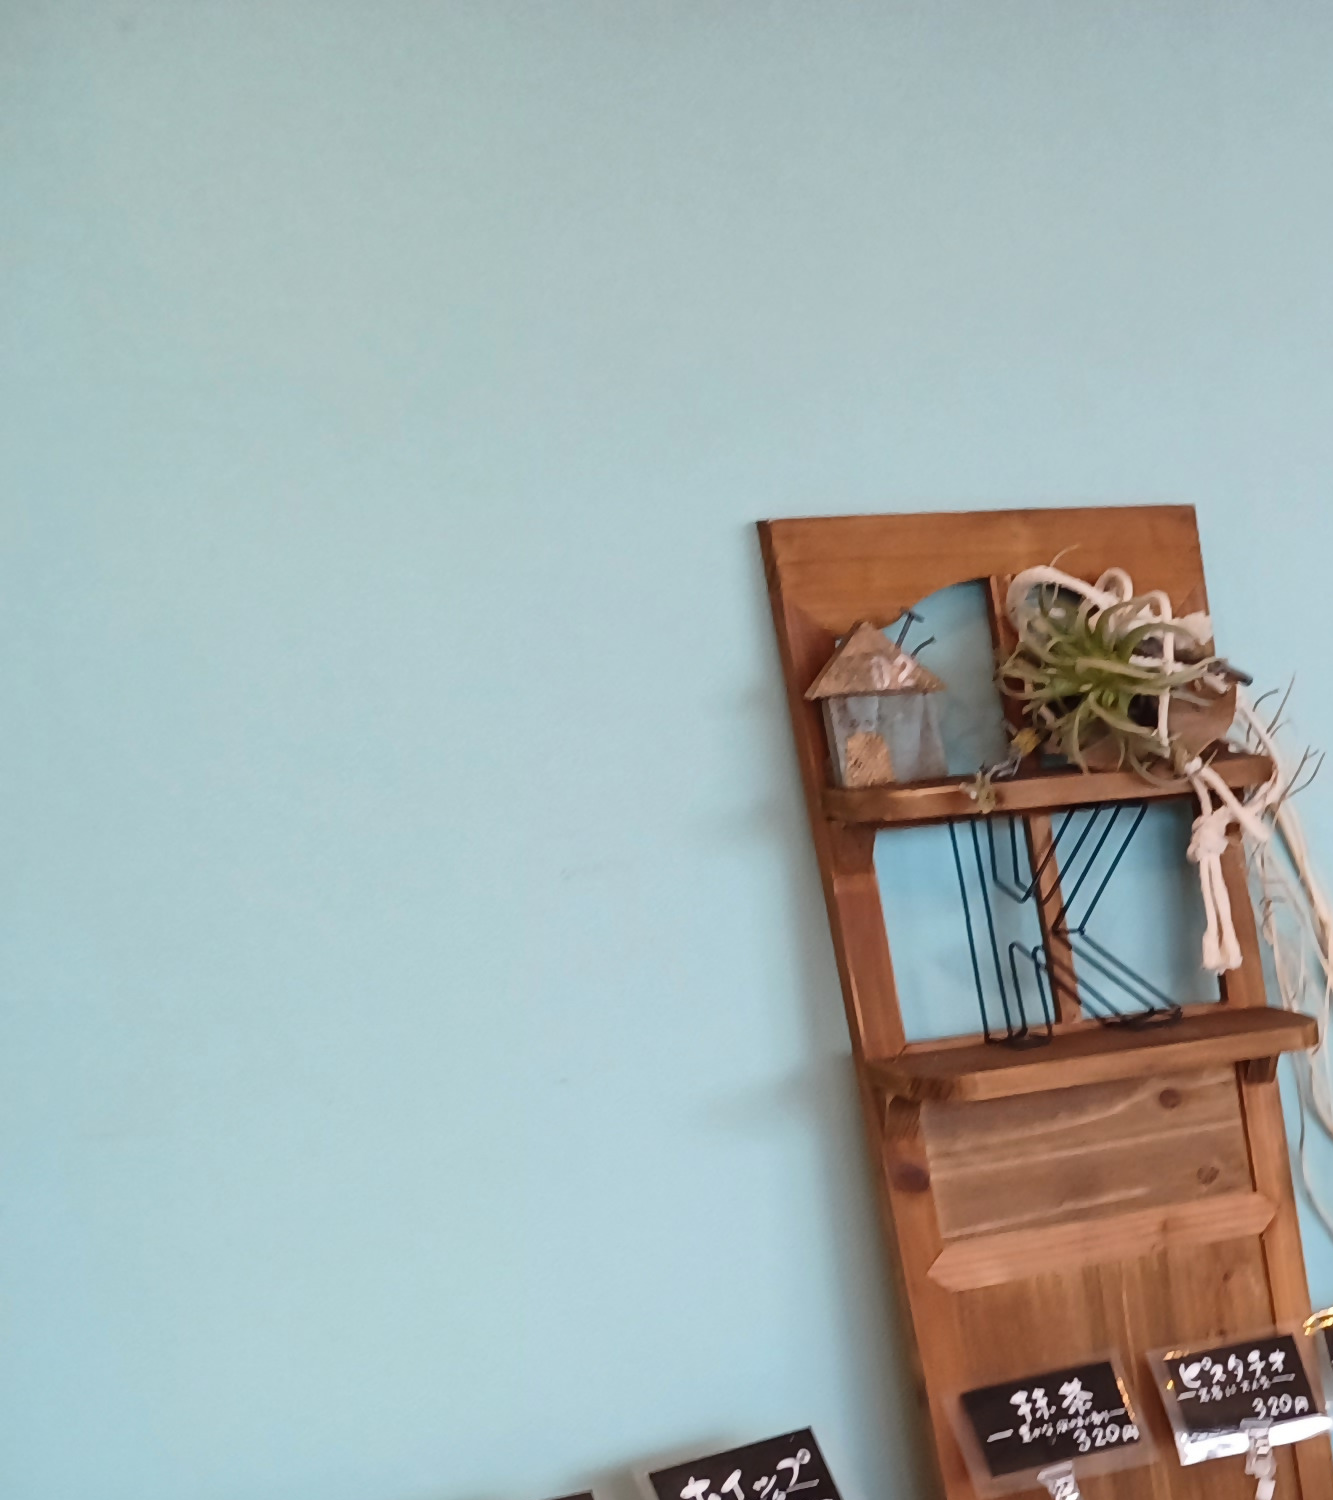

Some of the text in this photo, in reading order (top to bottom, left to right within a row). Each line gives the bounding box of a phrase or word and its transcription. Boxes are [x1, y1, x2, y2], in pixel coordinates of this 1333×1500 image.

[1178, 1349, 1286, 1389] ピスタチオ
[1252, 1393, 1310, 1420] 320円
[1073, 1423, 1140, 1452] 320円
